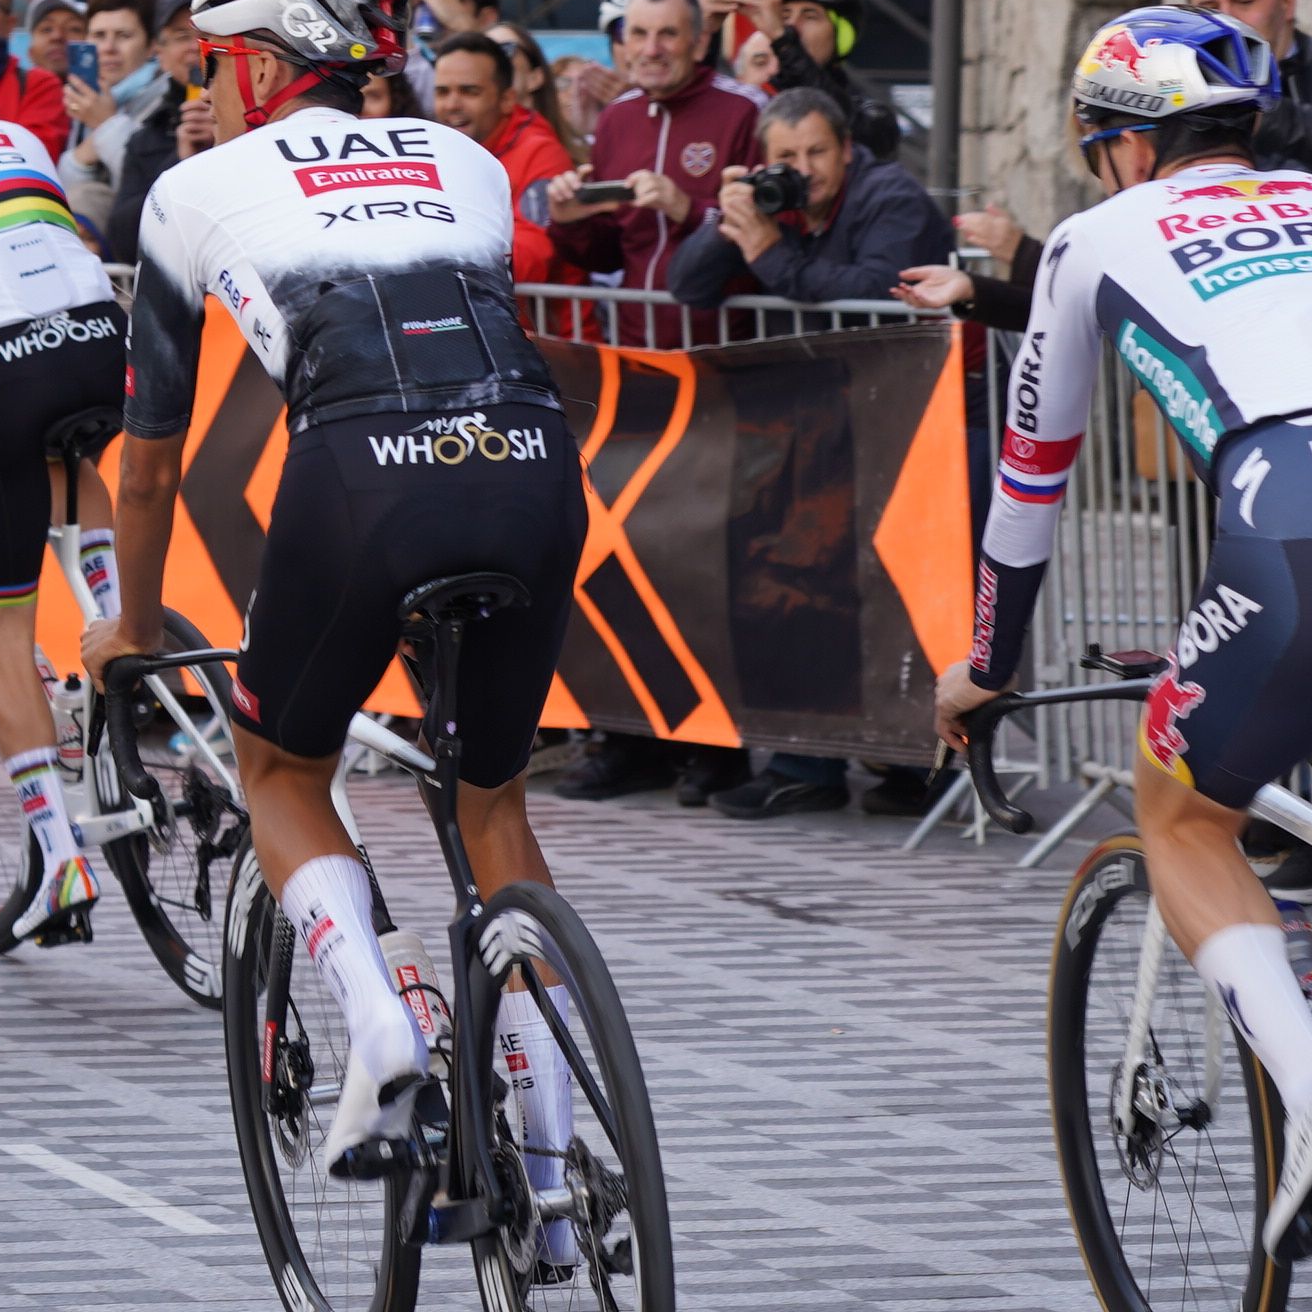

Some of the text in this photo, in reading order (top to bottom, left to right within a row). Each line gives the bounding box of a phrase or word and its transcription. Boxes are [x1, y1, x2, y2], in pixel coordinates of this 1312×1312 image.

[281, 2, 338, 54] G42
[275, 128, 435, 163] UAE
[309, 167, 430, 188] Emirates
[315, 200, 456, 229] XRG
[1157, 205, 1267, 241] Red
[1017, 331, 1047, 434] BORA
[1119, 321, 1218, 453] hansgrohe
[368, 427, 547, 466] WHOOSH
[1178, 583, 1264, 670] BORA
